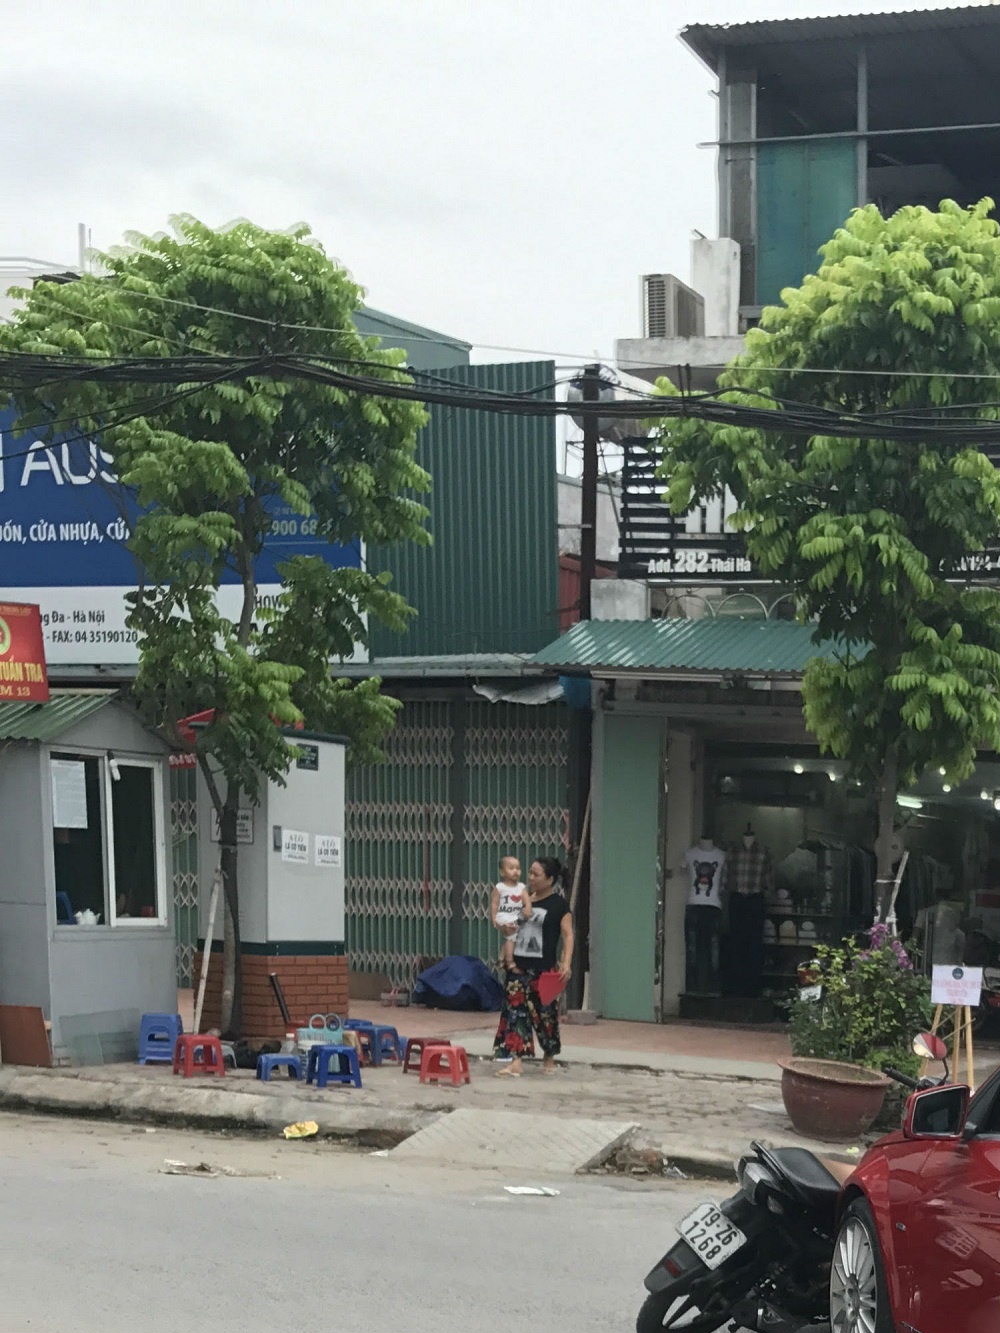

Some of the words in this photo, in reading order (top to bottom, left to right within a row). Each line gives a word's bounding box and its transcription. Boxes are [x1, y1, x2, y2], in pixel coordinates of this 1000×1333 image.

[29, 519, 57, 541] CỬA
[52, 610, 65, 623] Đa
[73, 610, 86, 623] Hà
[88, 610, 105, 626] Nội
[52, 631, 73, 643] FAX:
[75, 631, 87, 643] 04
[90, 630, 138, 643] 35190120
[684, 1221, 721, 1260] 1268
